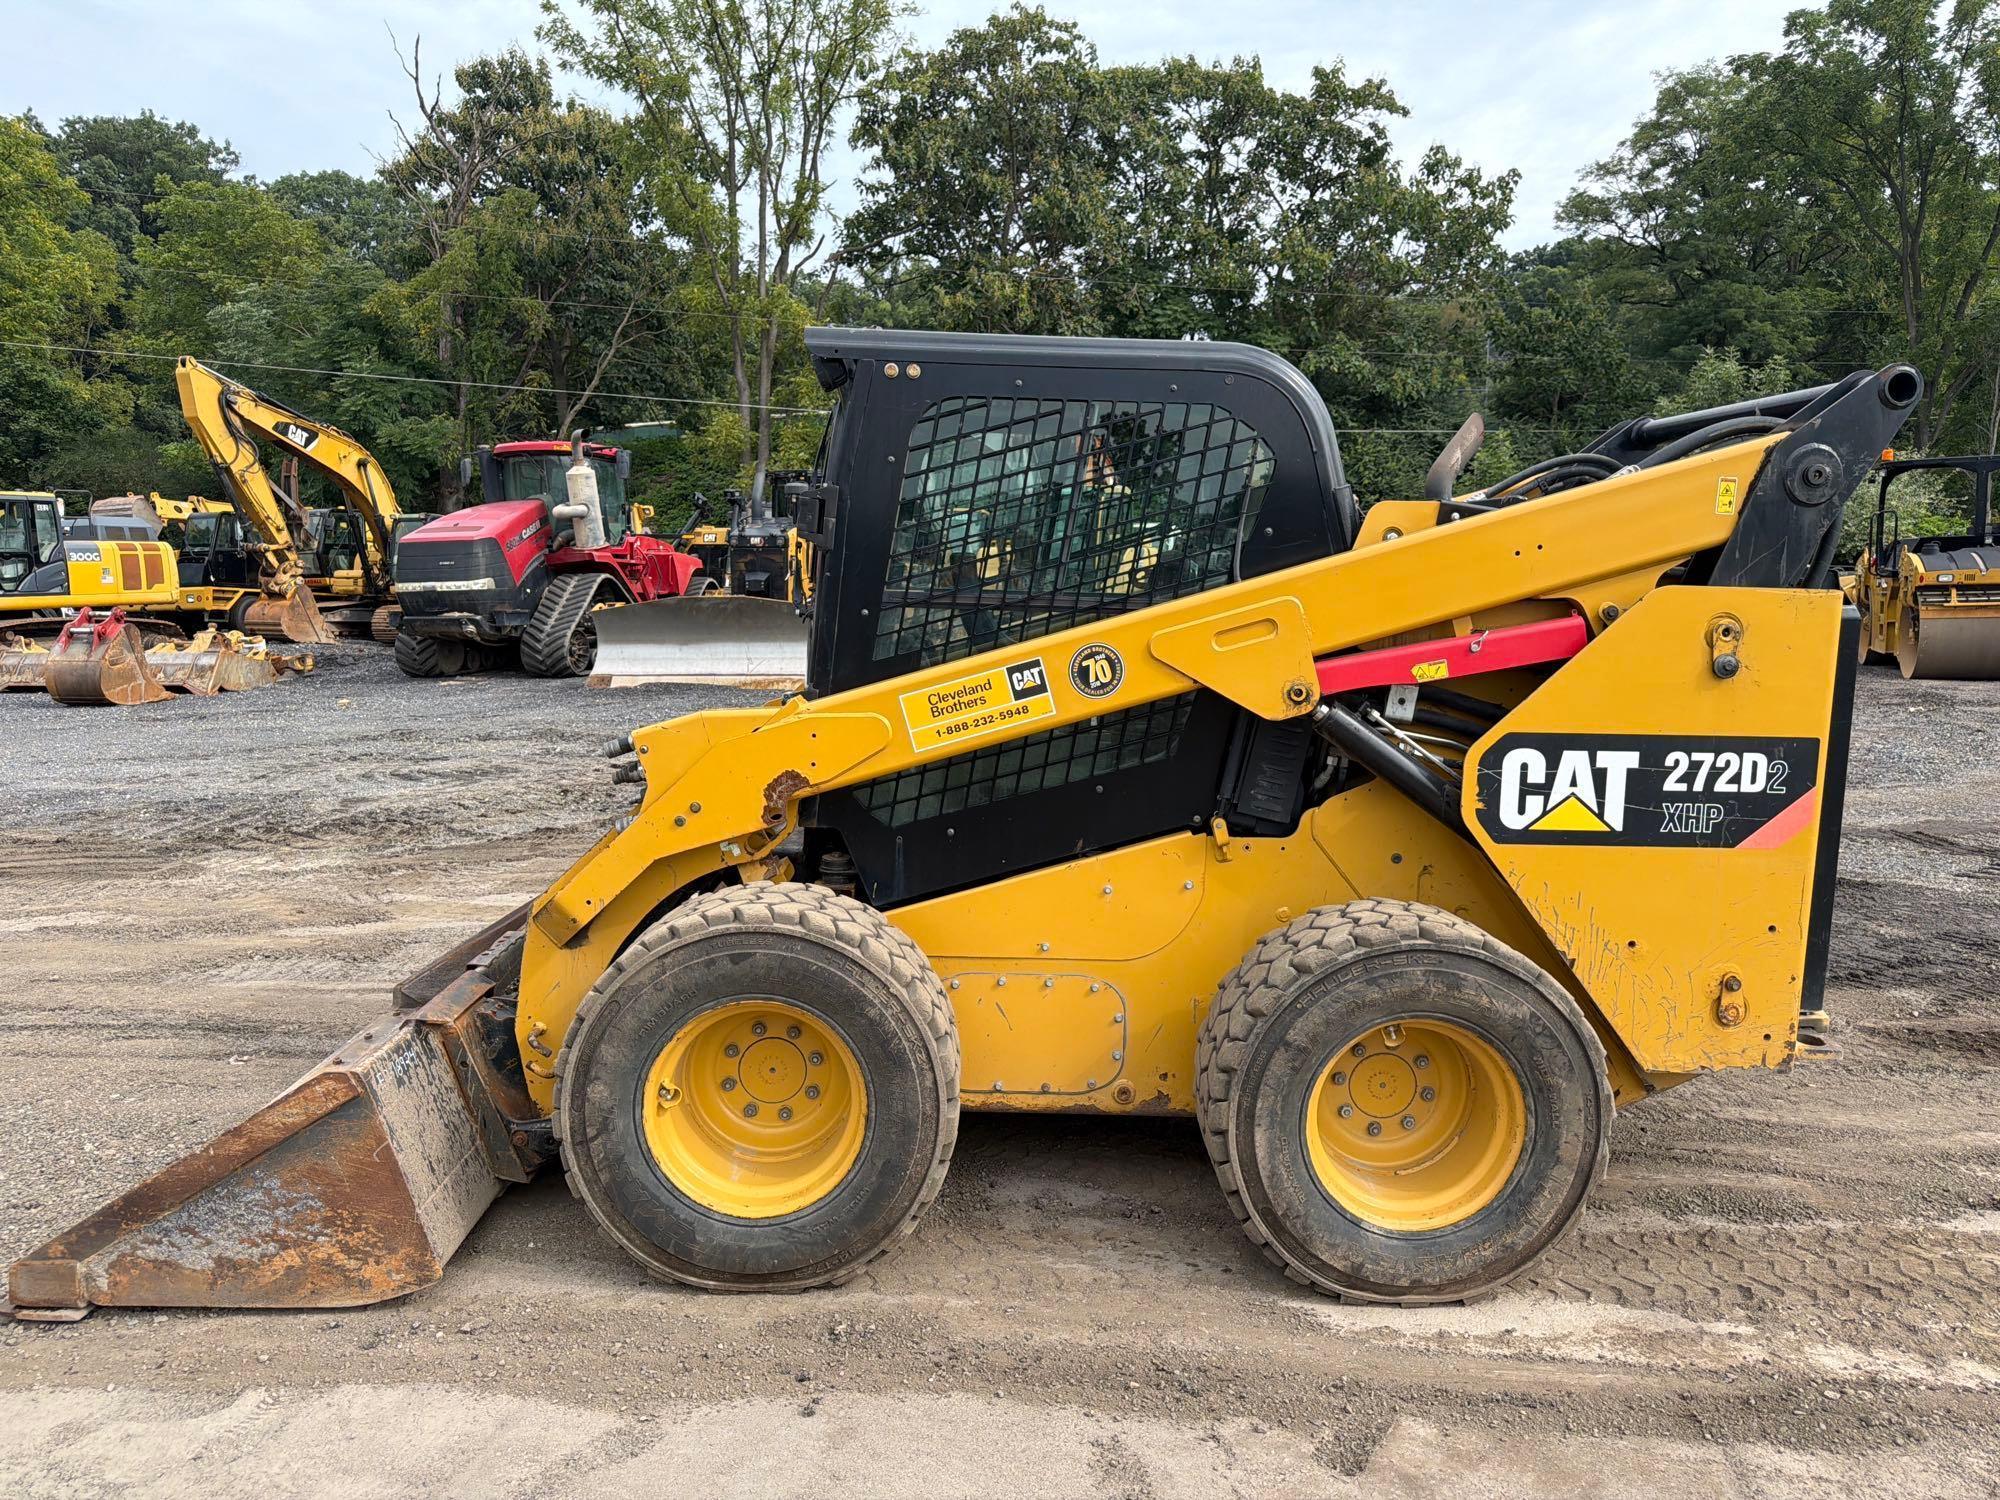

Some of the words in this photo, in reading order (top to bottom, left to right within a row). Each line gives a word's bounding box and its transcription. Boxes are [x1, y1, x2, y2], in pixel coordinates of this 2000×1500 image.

[287, 424, 310, 447] CAT
[703, 534, 716, 542] CAT
[69, 552, 101, 561] 300G
[1011, 667, 1042, 691] CAT
[1081, 657, 1112, 683] 70
[927, 678, 993, 706] Cleveland
[930, 695, 987, 718] Brothers
[935, 704, 1030, 738] 1-888-232-5948
[1662, 751, 1789, 794] 272D2
[1499, 747, 1640, 832] CAT
[1660, 803, 1724, 833] XHP
